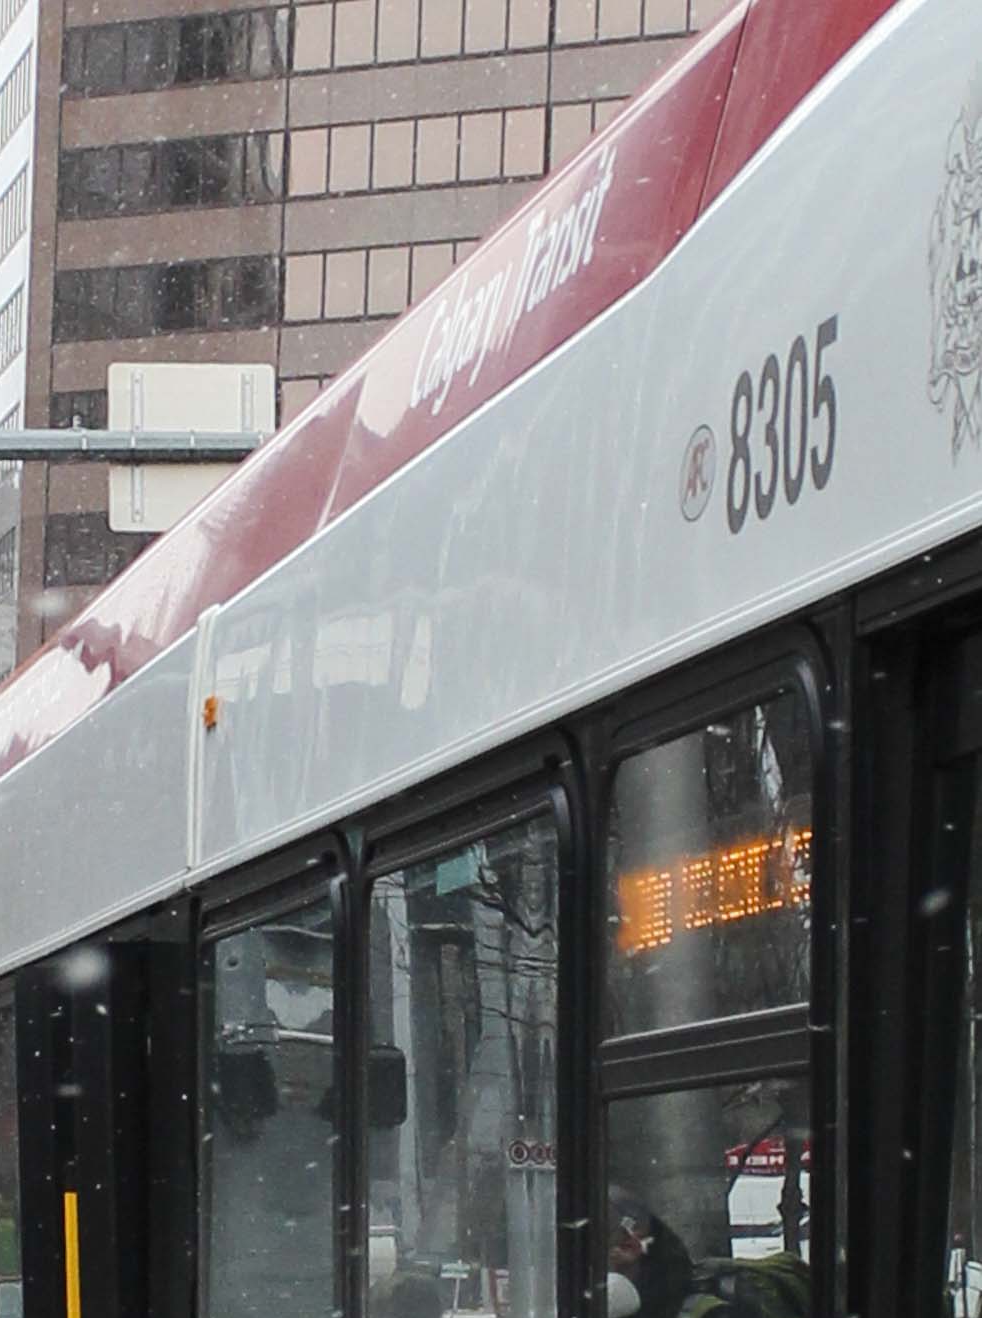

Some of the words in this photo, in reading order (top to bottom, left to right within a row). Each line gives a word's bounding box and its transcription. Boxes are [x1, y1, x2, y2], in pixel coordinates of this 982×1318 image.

[410, 265, 513, 416] Calgary
[506, 143, 618, 327] Transit
[726, 313, 838, 535] 8305
